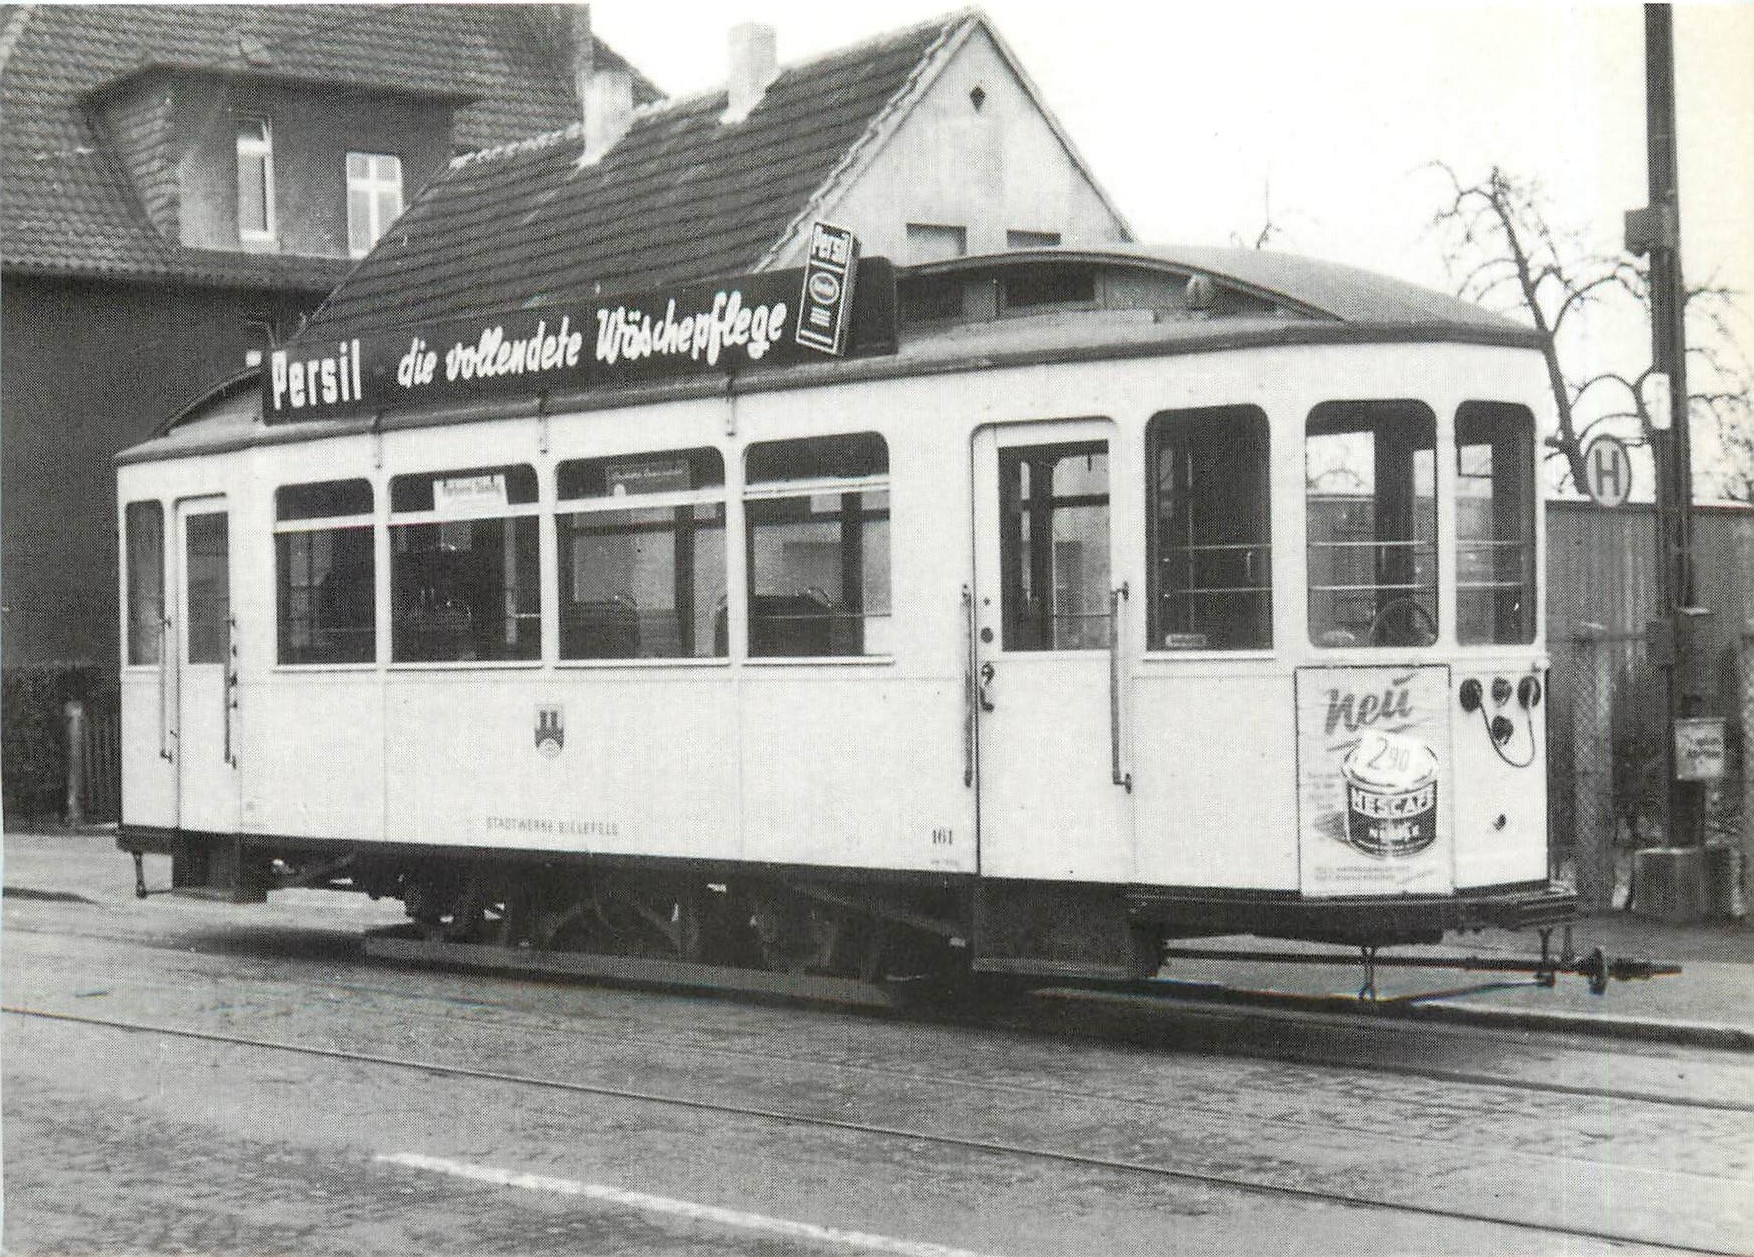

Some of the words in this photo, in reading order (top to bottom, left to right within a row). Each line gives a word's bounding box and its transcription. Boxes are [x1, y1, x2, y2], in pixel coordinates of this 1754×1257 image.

[811, 224, 850, 265] Persil
[272, 338, 362, 410] Persil
[397, 336, 438, 388] die
[446, 316, 583, 382] vollendete
[1595, 449, 1621, 497] H
[486, 816, 554, 834] STADTWERKE
[558, 820, 619, 837] BIELEFELD
[932, 828, 953, 845] 161
